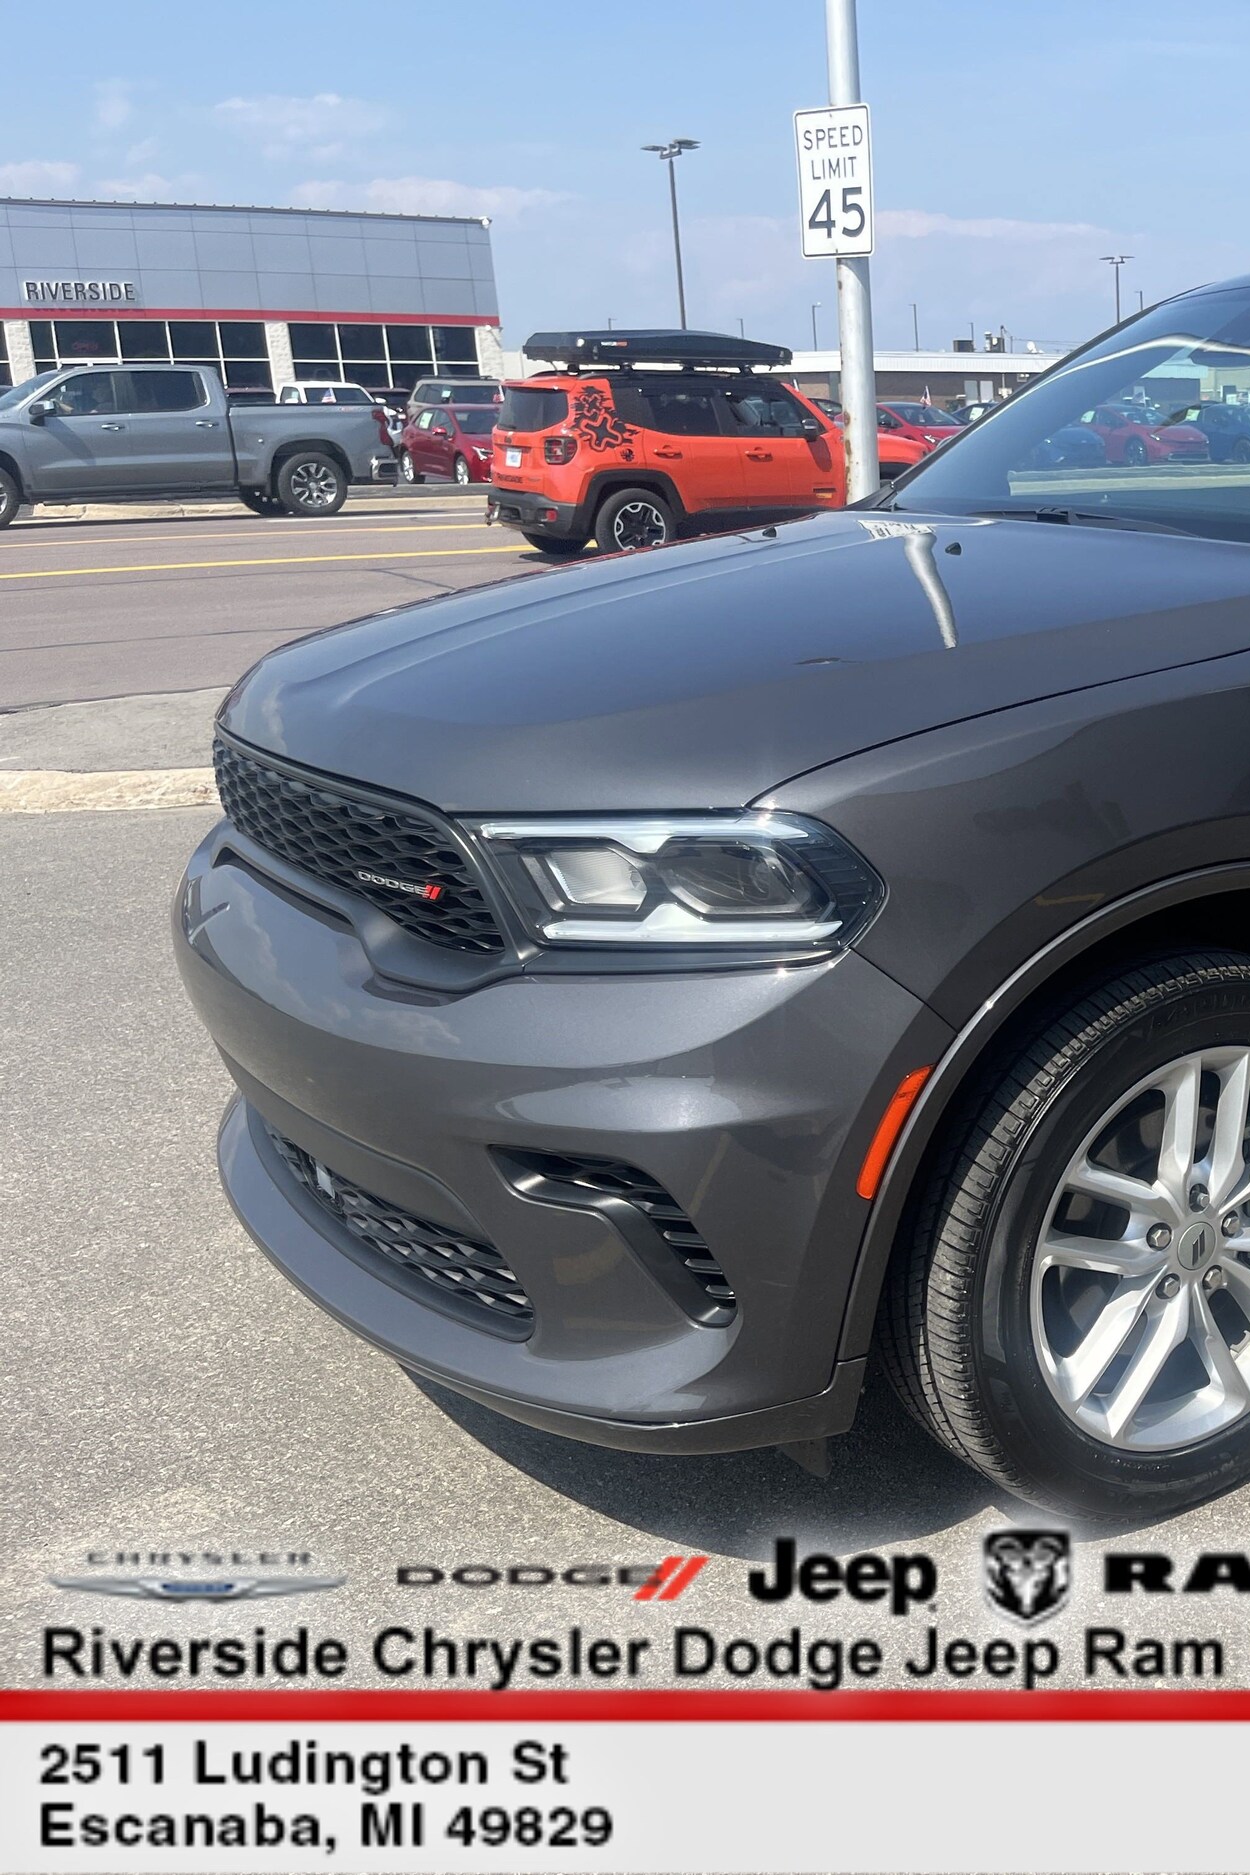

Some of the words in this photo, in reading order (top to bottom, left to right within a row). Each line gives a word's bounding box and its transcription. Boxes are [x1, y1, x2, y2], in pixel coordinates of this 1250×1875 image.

[803, 125, 863, 151] SPEED
[811, 156, 857, 180] LIMIT
[808, 186, 865, 238] 45
[24, 281, 136, 301] RIVERSIDE
[358, 871, 428, 897] DODGE
